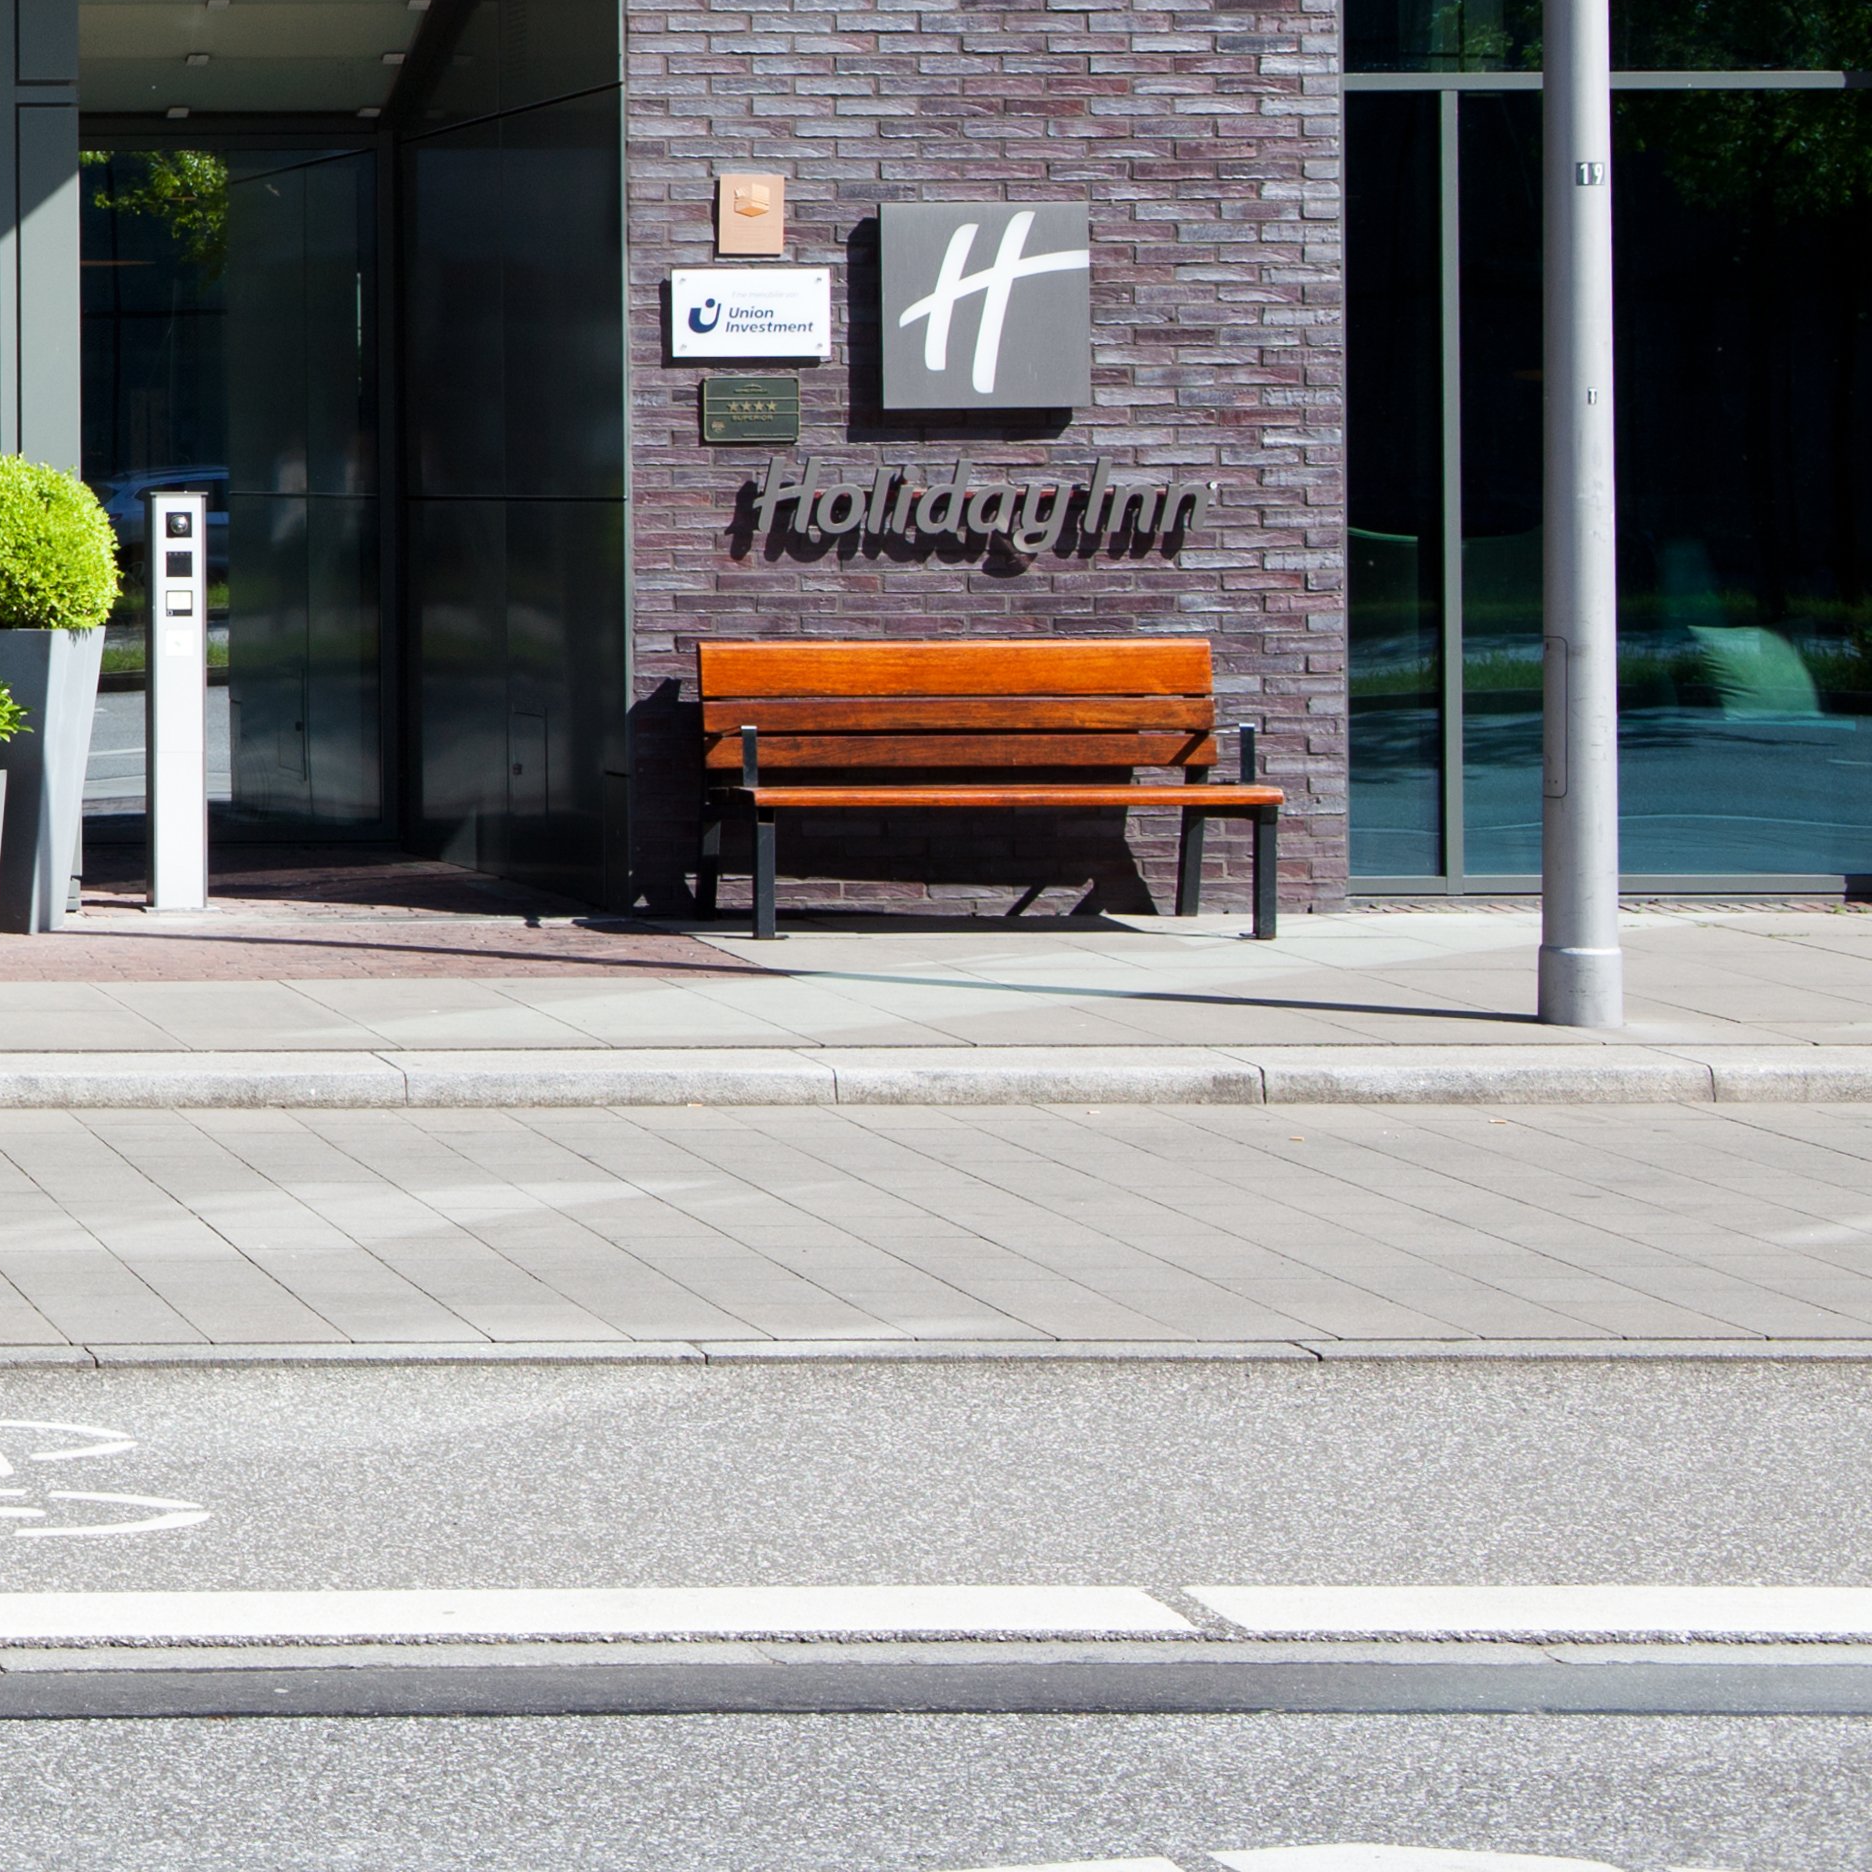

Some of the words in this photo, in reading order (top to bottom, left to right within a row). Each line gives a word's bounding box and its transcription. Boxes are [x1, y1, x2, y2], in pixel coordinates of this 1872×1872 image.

[1580, 163, 1603, 185] 19
[728, 306, 774, 319] Union
[898, 210, 1090, 394] H
[725, 322, 814, 333] Investment
[753, 457, 1073, 555] Holiday
[1082, 456, 1212, 534] Inn
